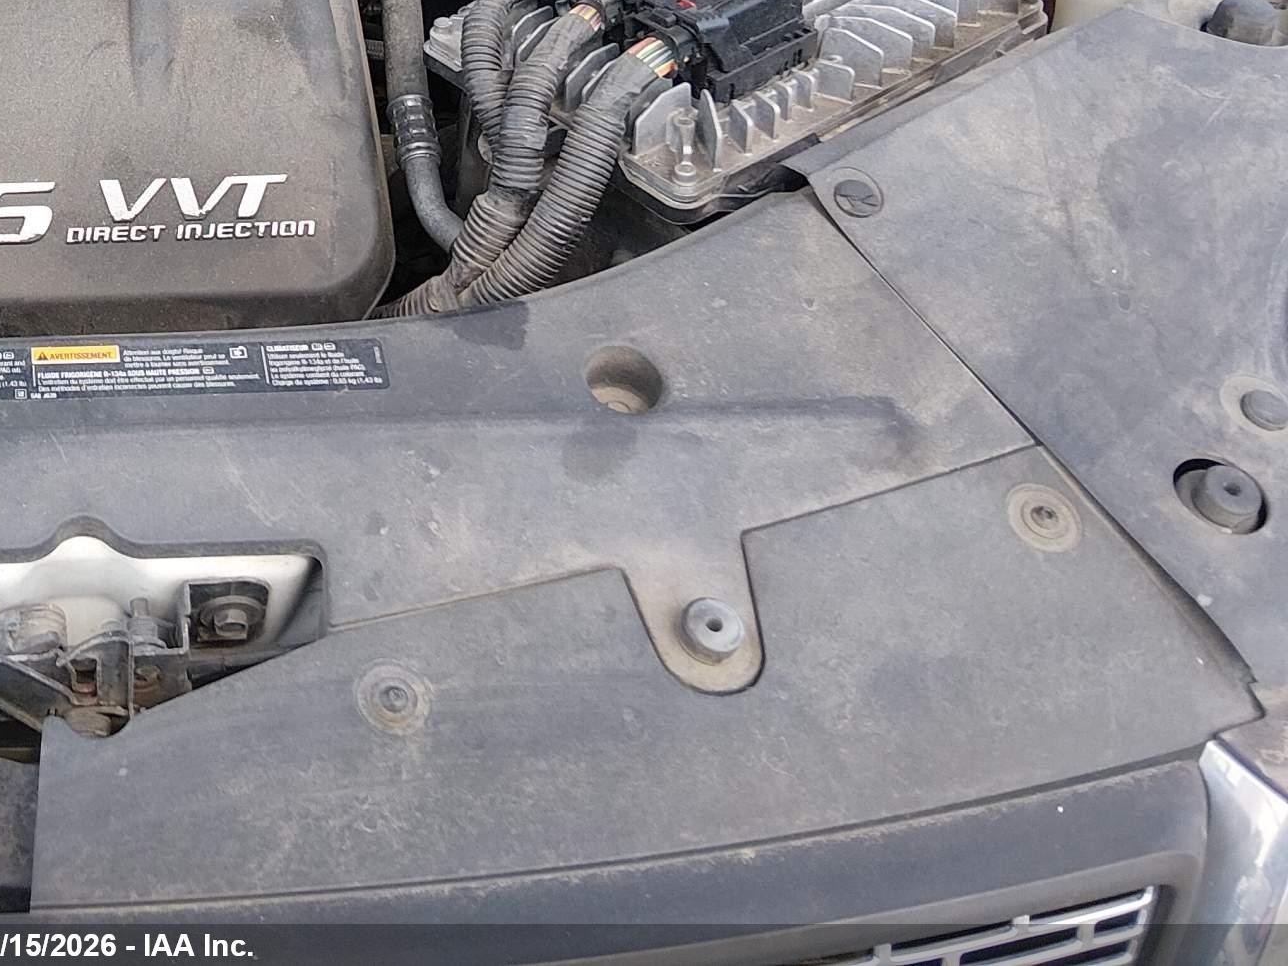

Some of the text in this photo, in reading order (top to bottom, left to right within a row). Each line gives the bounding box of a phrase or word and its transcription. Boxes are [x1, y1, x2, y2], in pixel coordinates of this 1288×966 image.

[99, 174, 288, 222] VVT
[65, 220, 316, 244] DIRECT INJECTION
[49, 351, 112, 360] AVERTISSEMENT
